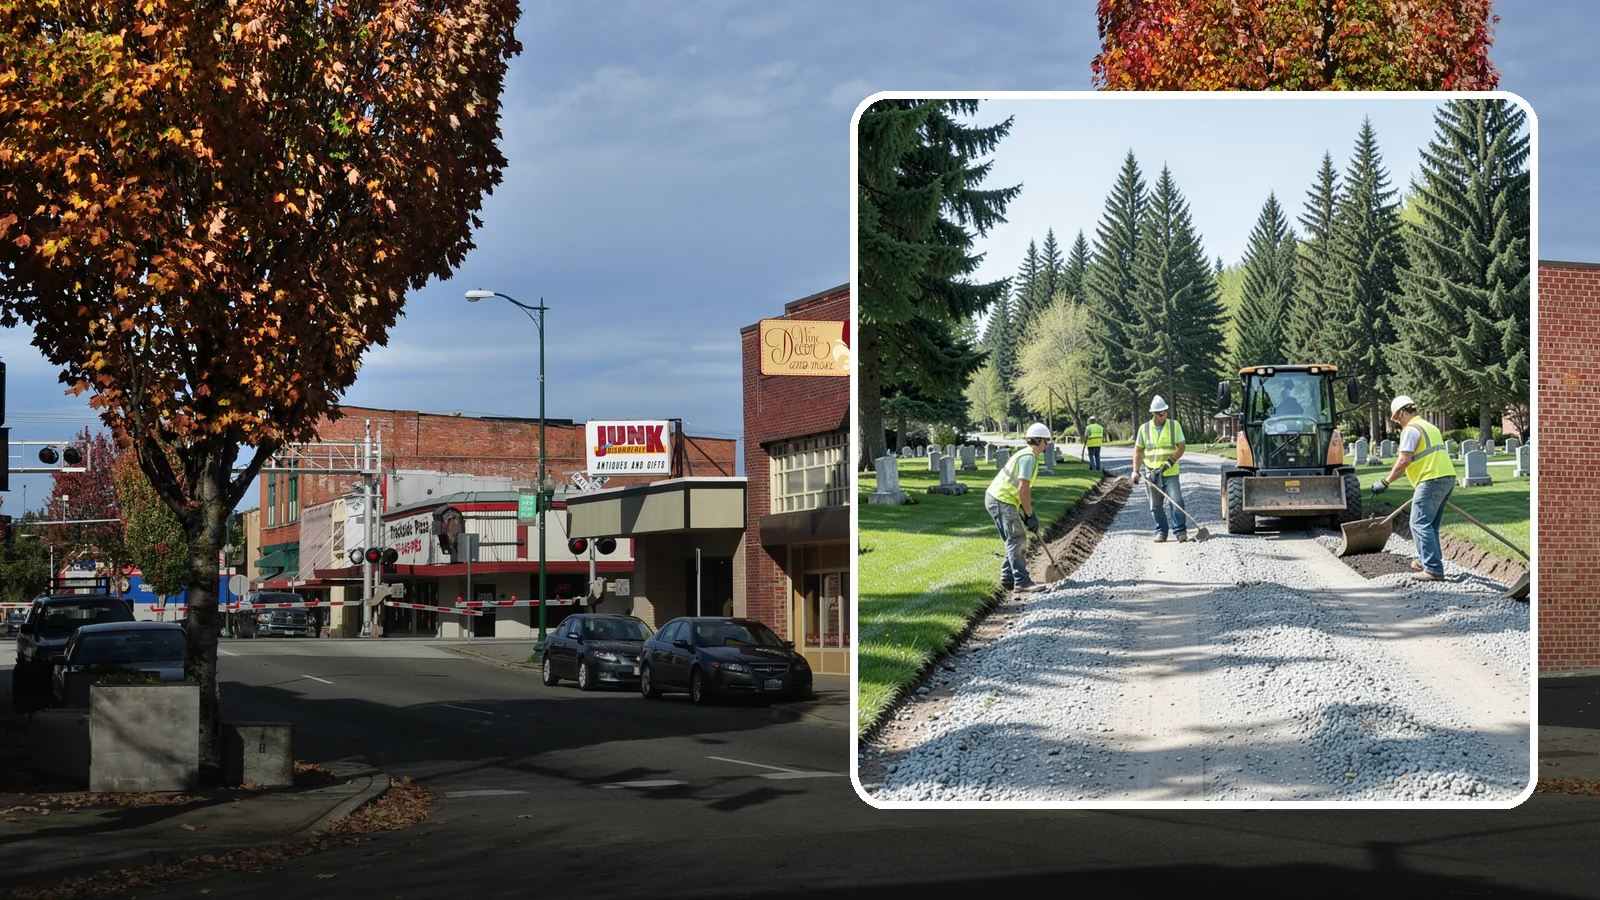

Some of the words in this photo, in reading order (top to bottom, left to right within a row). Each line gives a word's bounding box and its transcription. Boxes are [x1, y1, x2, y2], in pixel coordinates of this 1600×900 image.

[595, 425, 665, 457] JUNK
[607, 446, 646, 454] DISORDERLY
[597, 461, 628, 470] ANTIQUES
[631, 461, 644, 470] AND
[647, 460, 665, 470] GIFTS
[390, 522, 413, 539] Trackside
[414, 520, 429, 535] Pizza
